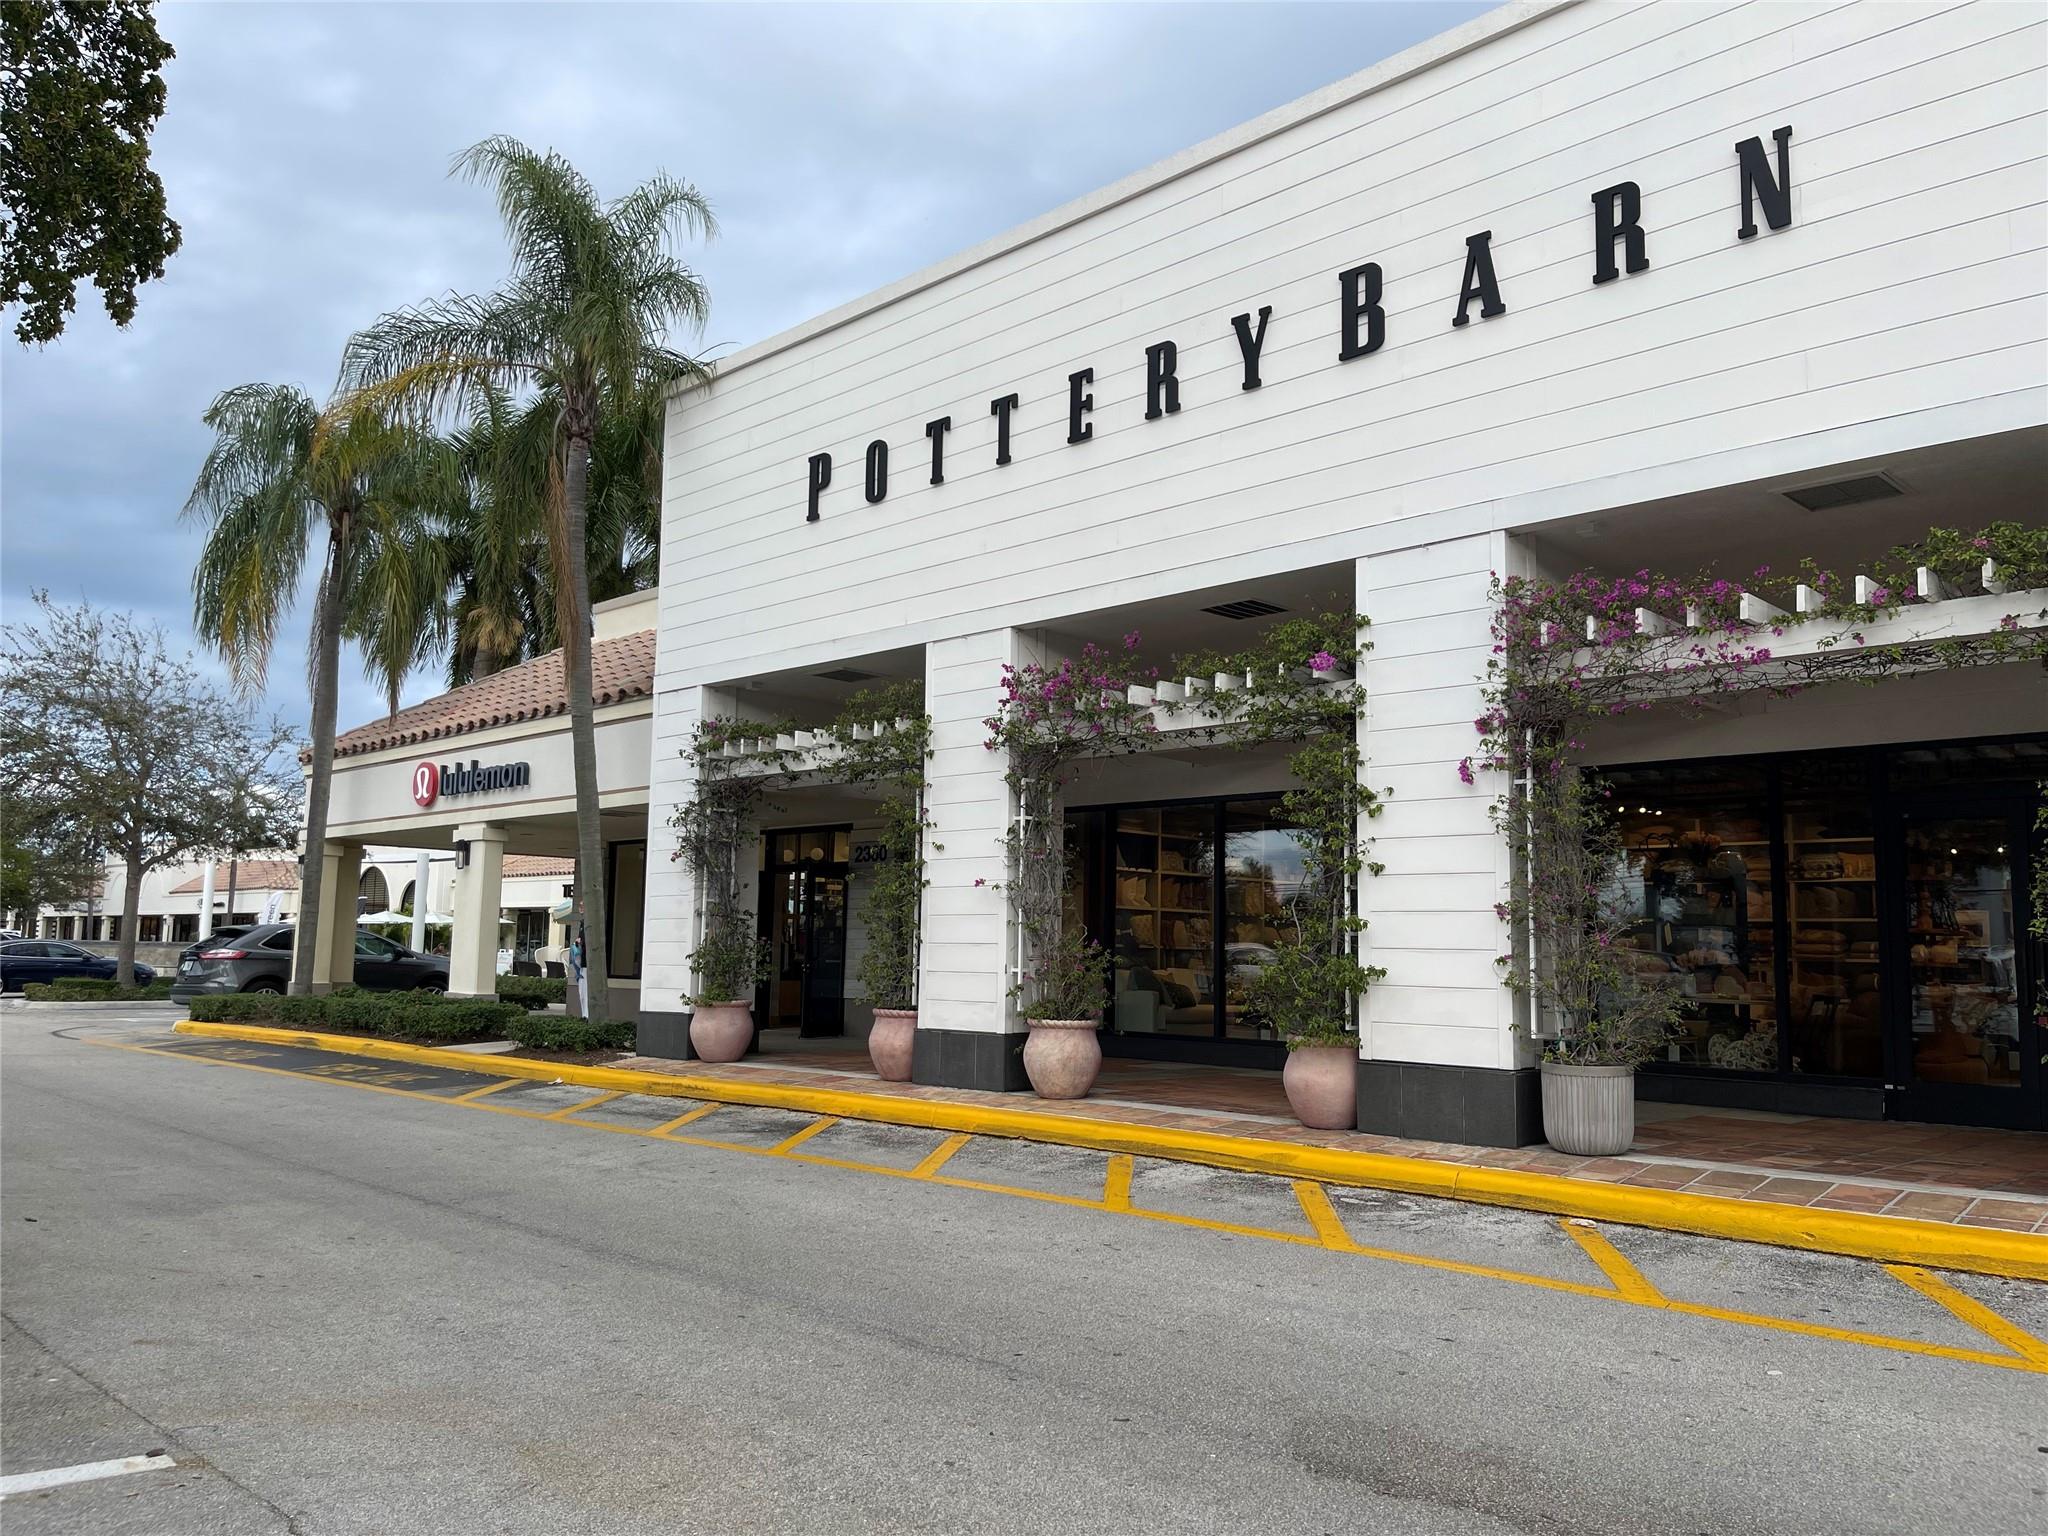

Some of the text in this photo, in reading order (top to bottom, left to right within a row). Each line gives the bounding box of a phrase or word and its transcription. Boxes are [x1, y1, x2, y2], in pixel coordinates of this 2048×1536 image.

[805, 124, 1793, 523] POTTERY BARN
[440, 760, 530, 796] lululemon
